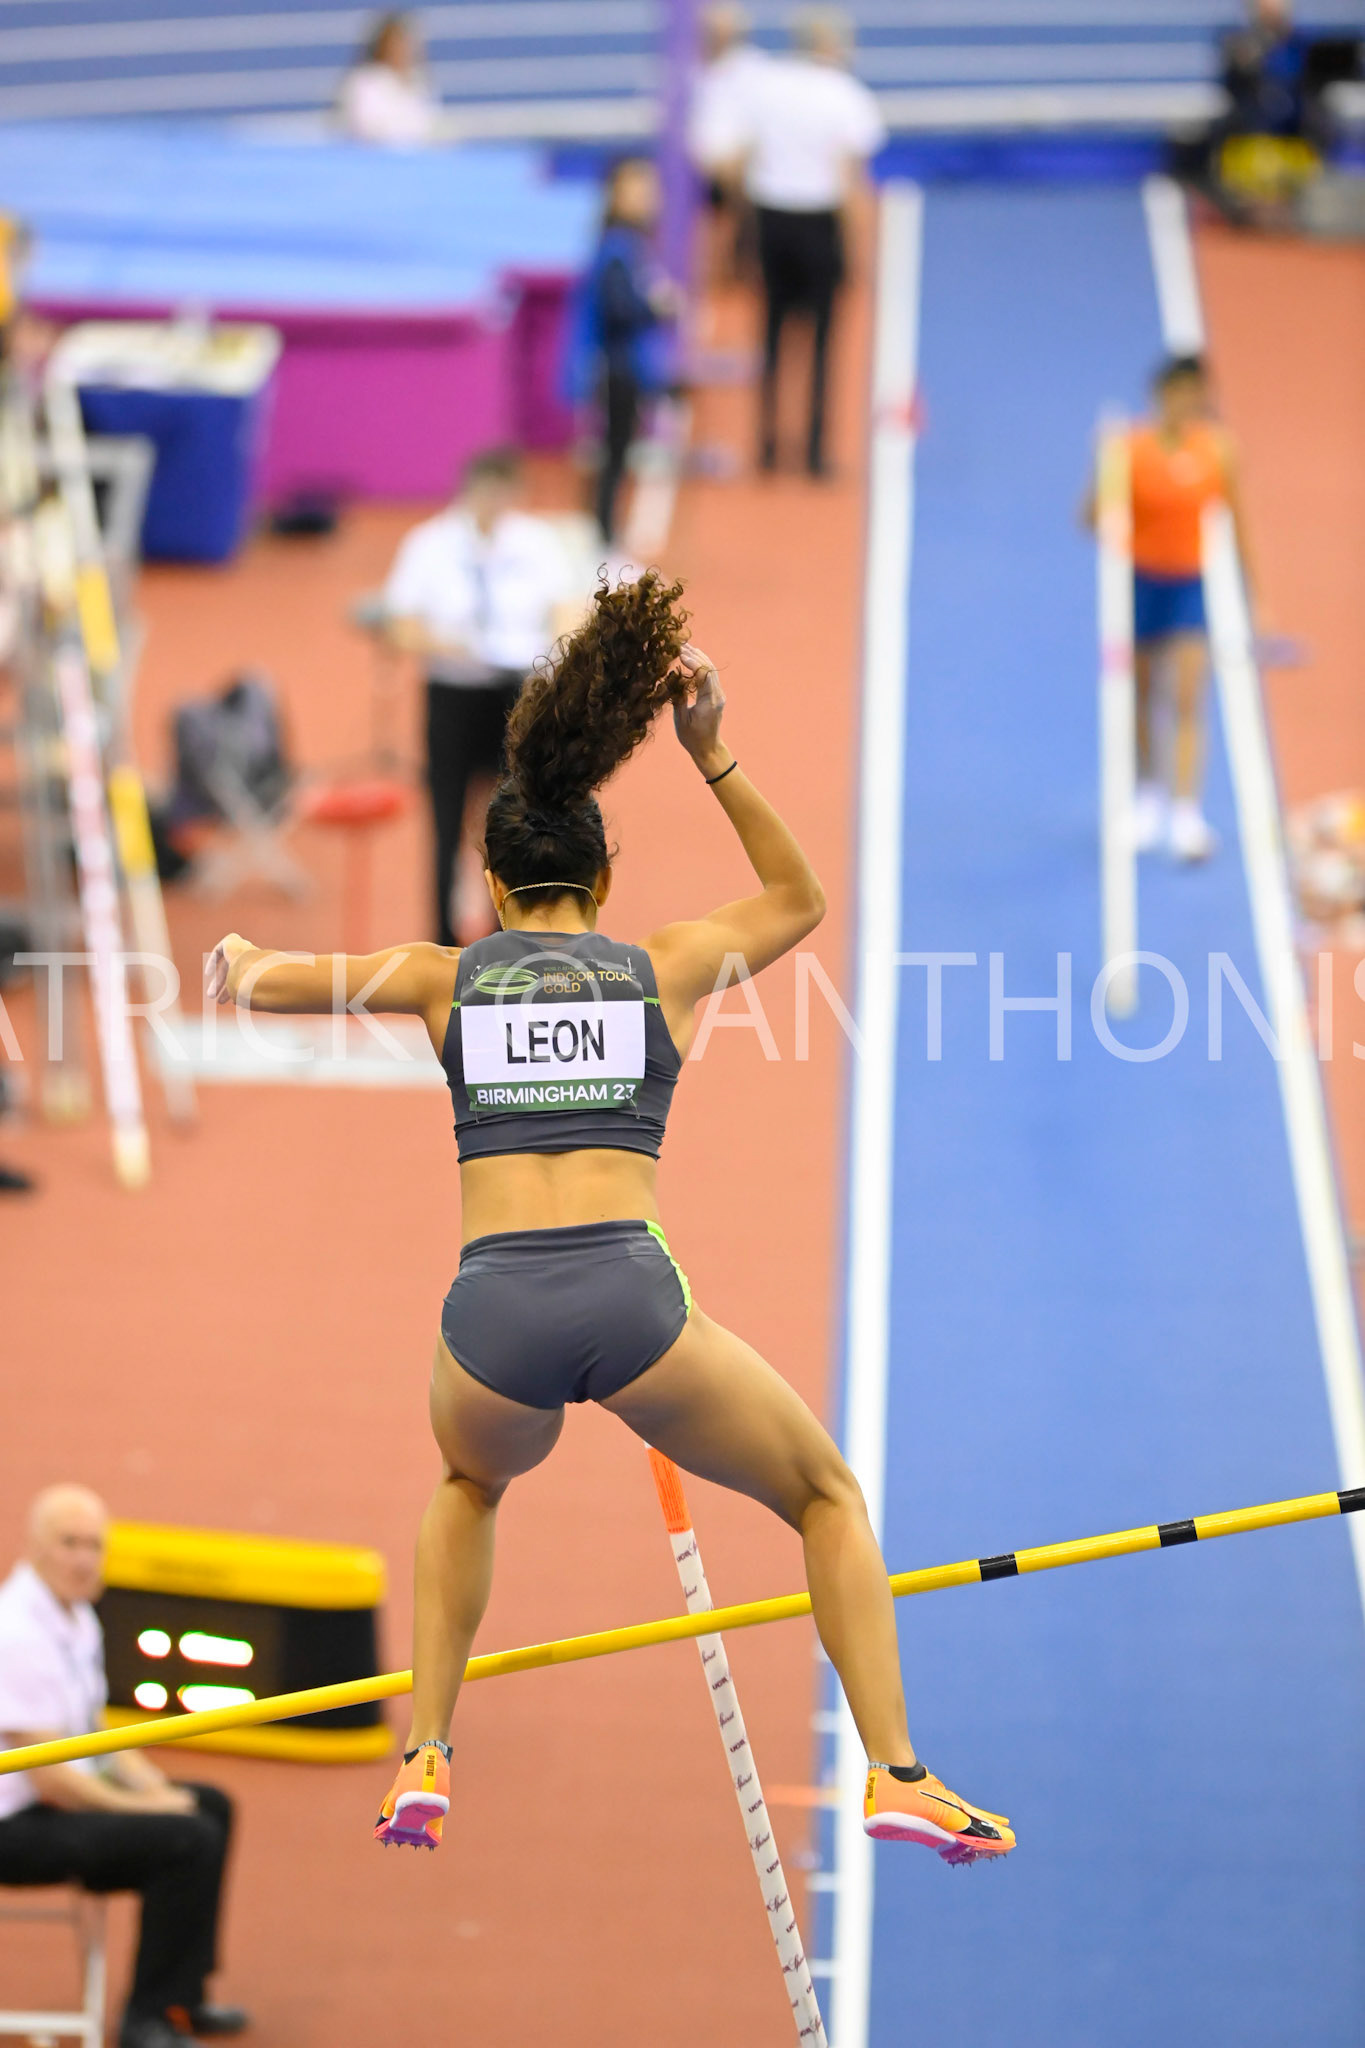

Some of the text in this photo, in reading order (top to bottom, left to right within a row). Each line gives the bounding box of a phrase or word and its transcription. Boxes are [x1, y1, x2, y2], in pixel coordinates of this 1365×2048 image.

[543, 971, 595, 983] INDOOR
[543, 982, 581, 994] GOLD
[505, 1019, 605, 1064] LEON
[476, 1083, 636, 1105] BIRMINGHAM 23
